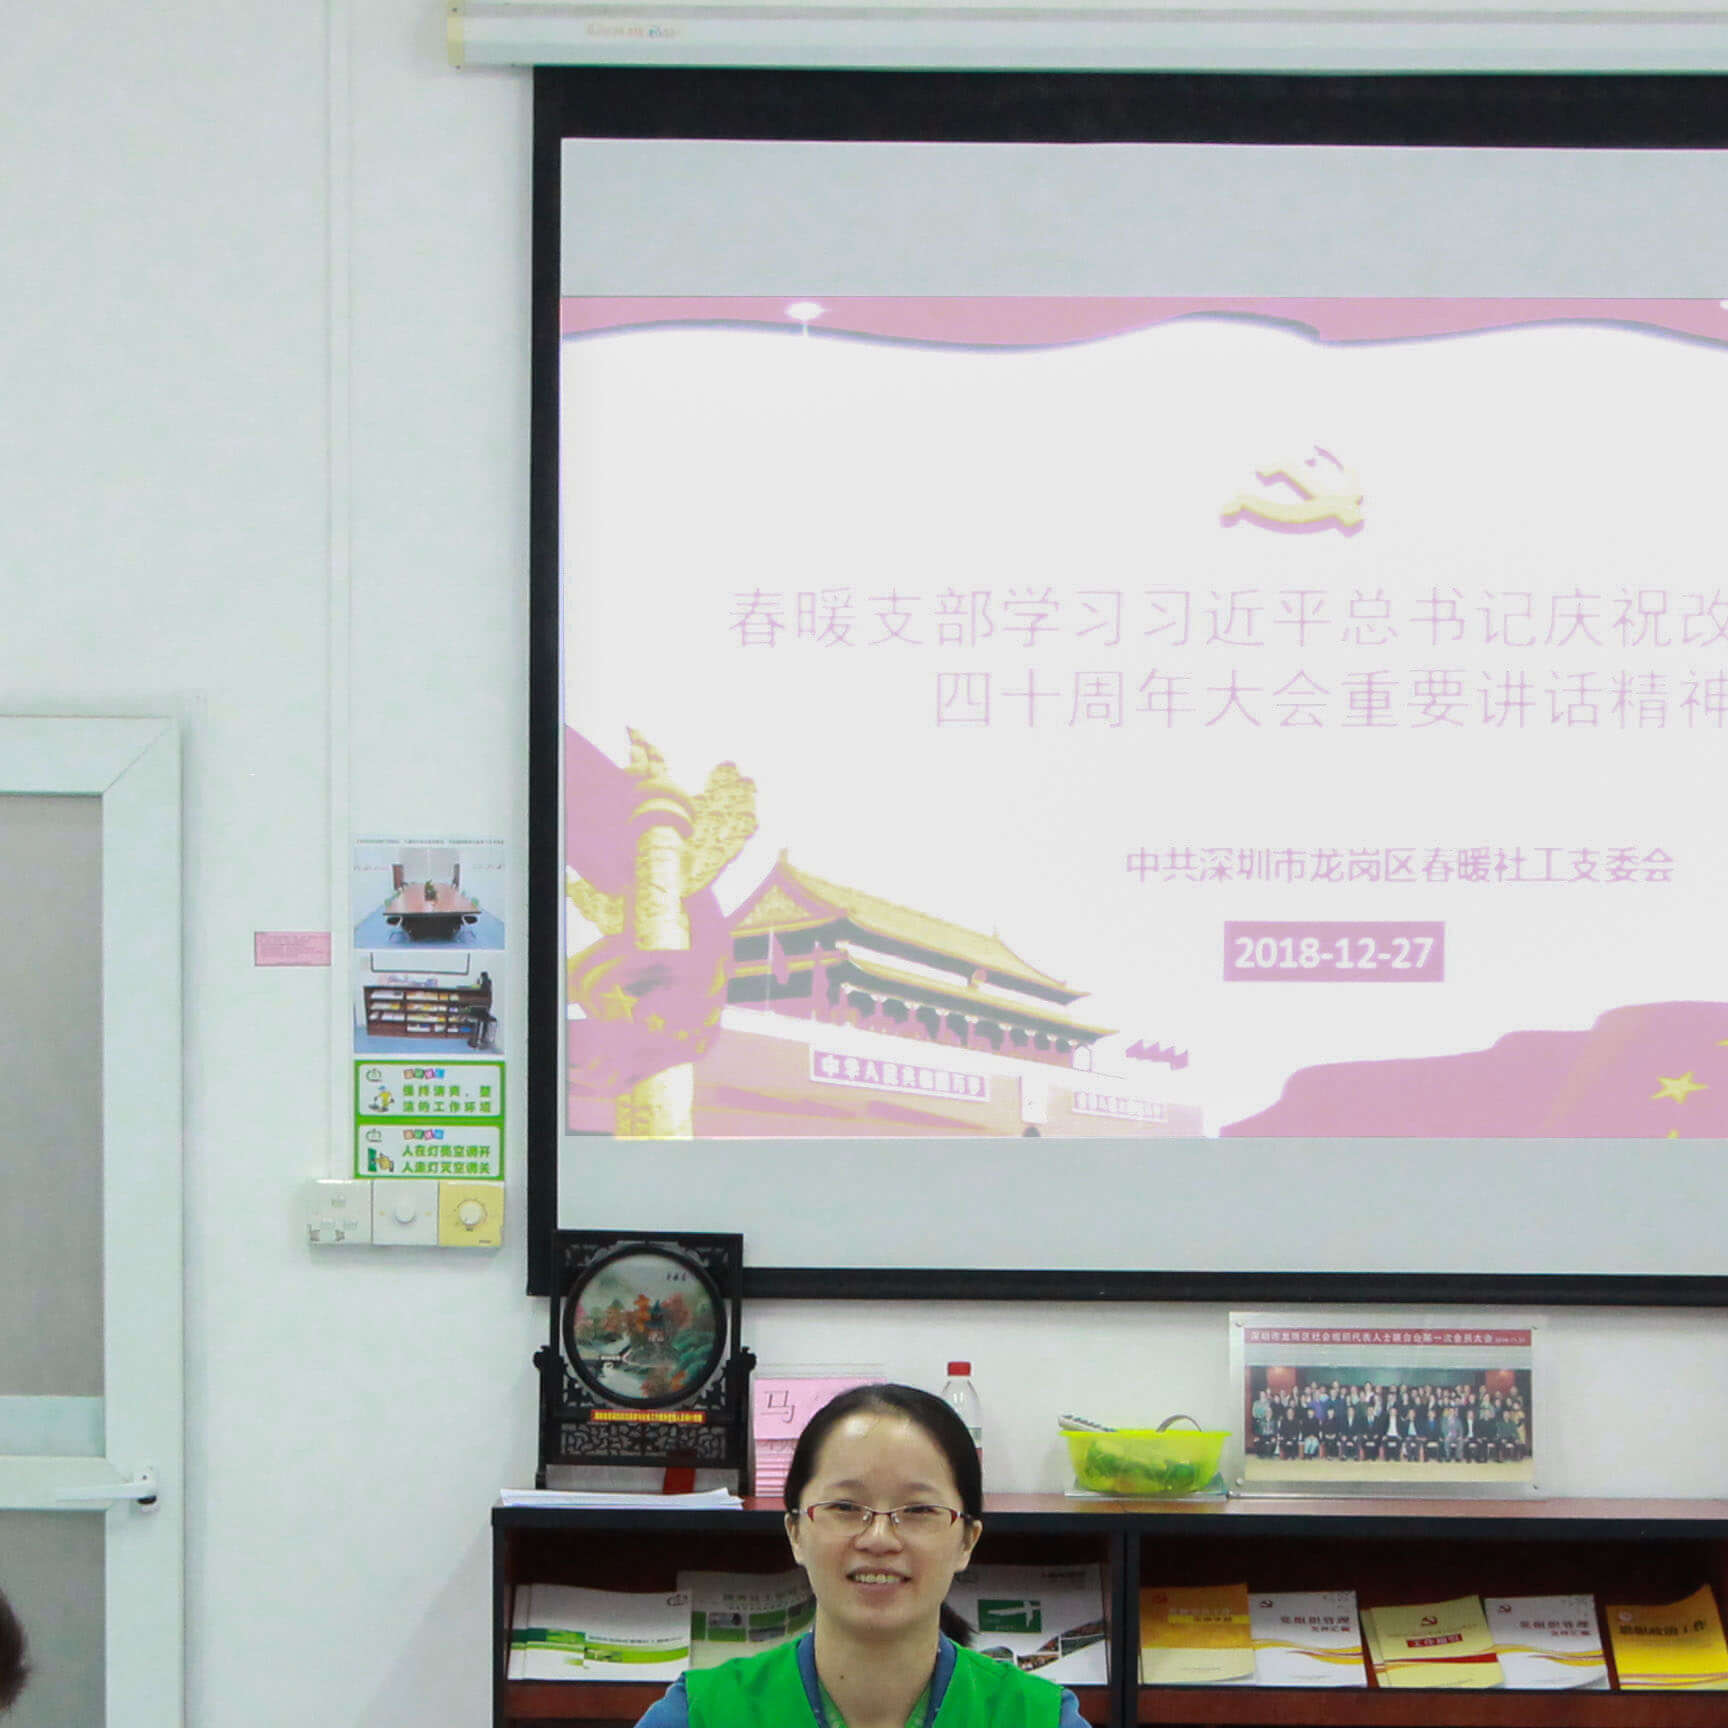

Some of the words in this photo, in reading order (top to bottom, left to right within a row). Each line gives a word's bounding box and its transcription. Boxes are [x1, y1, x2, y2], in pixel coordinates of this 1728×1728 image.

[1125, 845, 1674, 885] 中共深圳市龙岗区春暖社工支委会
[1234, 935, 1435, 970] 2018-12-27
